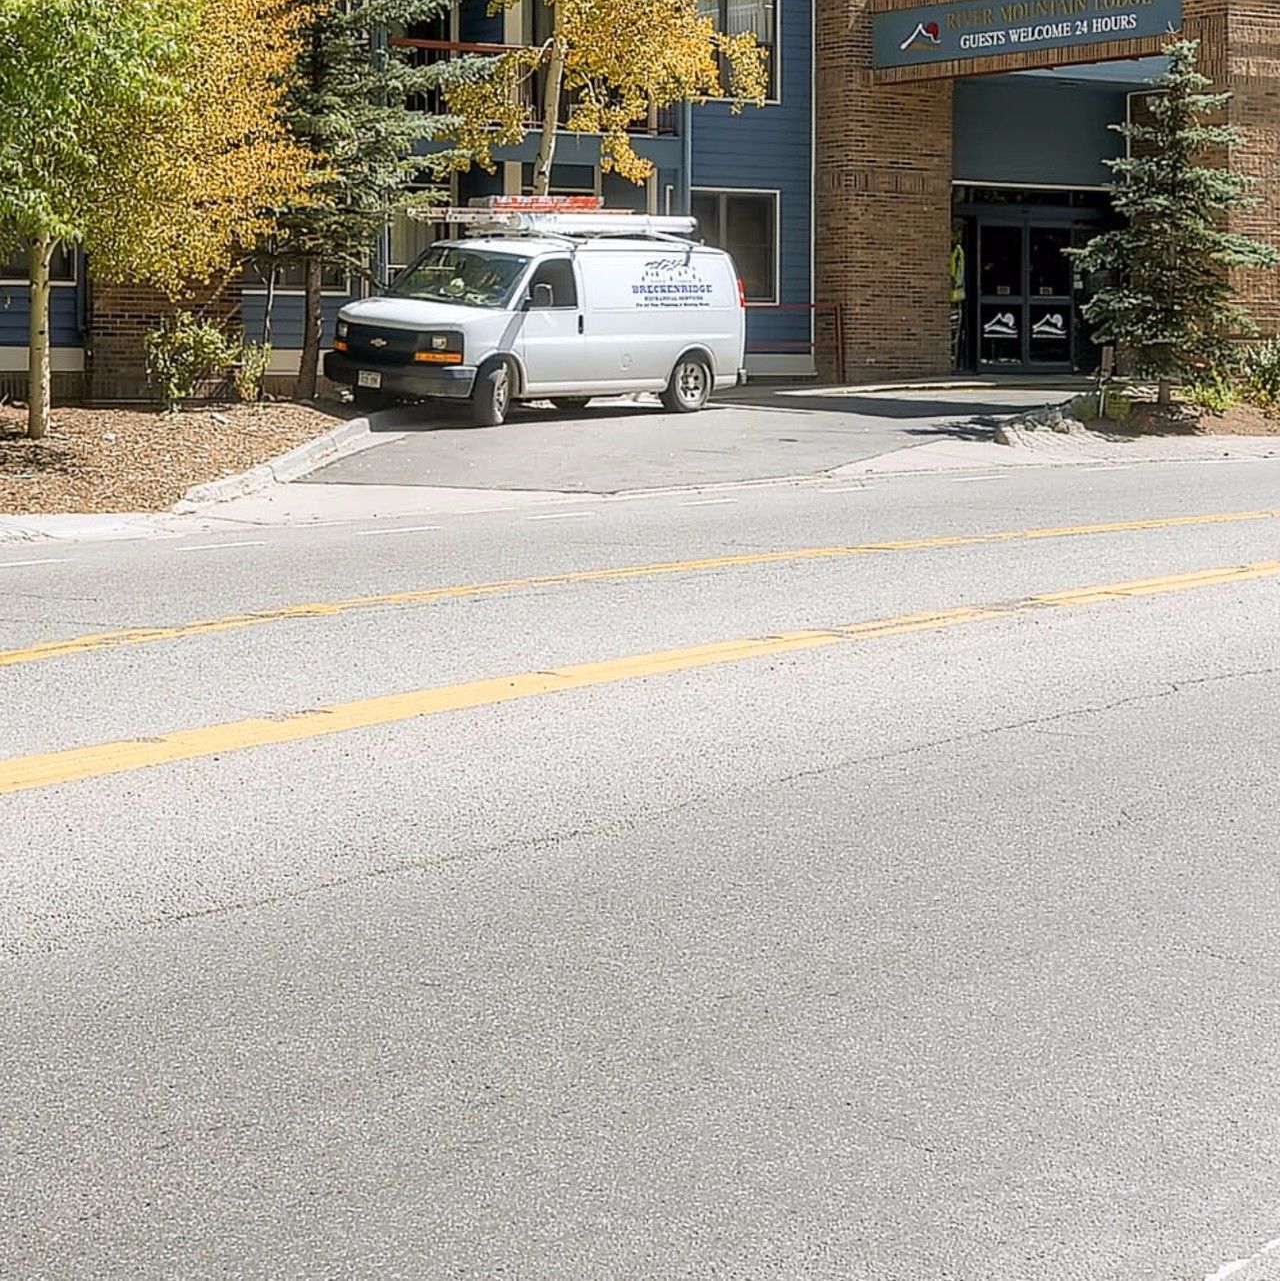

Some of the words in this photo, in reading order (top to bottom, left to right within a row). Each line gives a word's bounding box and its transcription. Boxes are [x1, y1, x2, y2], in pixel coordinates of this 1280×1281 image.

[960, 31, 1006, 49] GUESTS
[1009, 22, 1072, 42] WELCOME
[1075, 19, 1089, 35] 24
[1092, 14, 1137, 33] HOURS
[632, 284, 713, 294] BRECKENRIDGE
